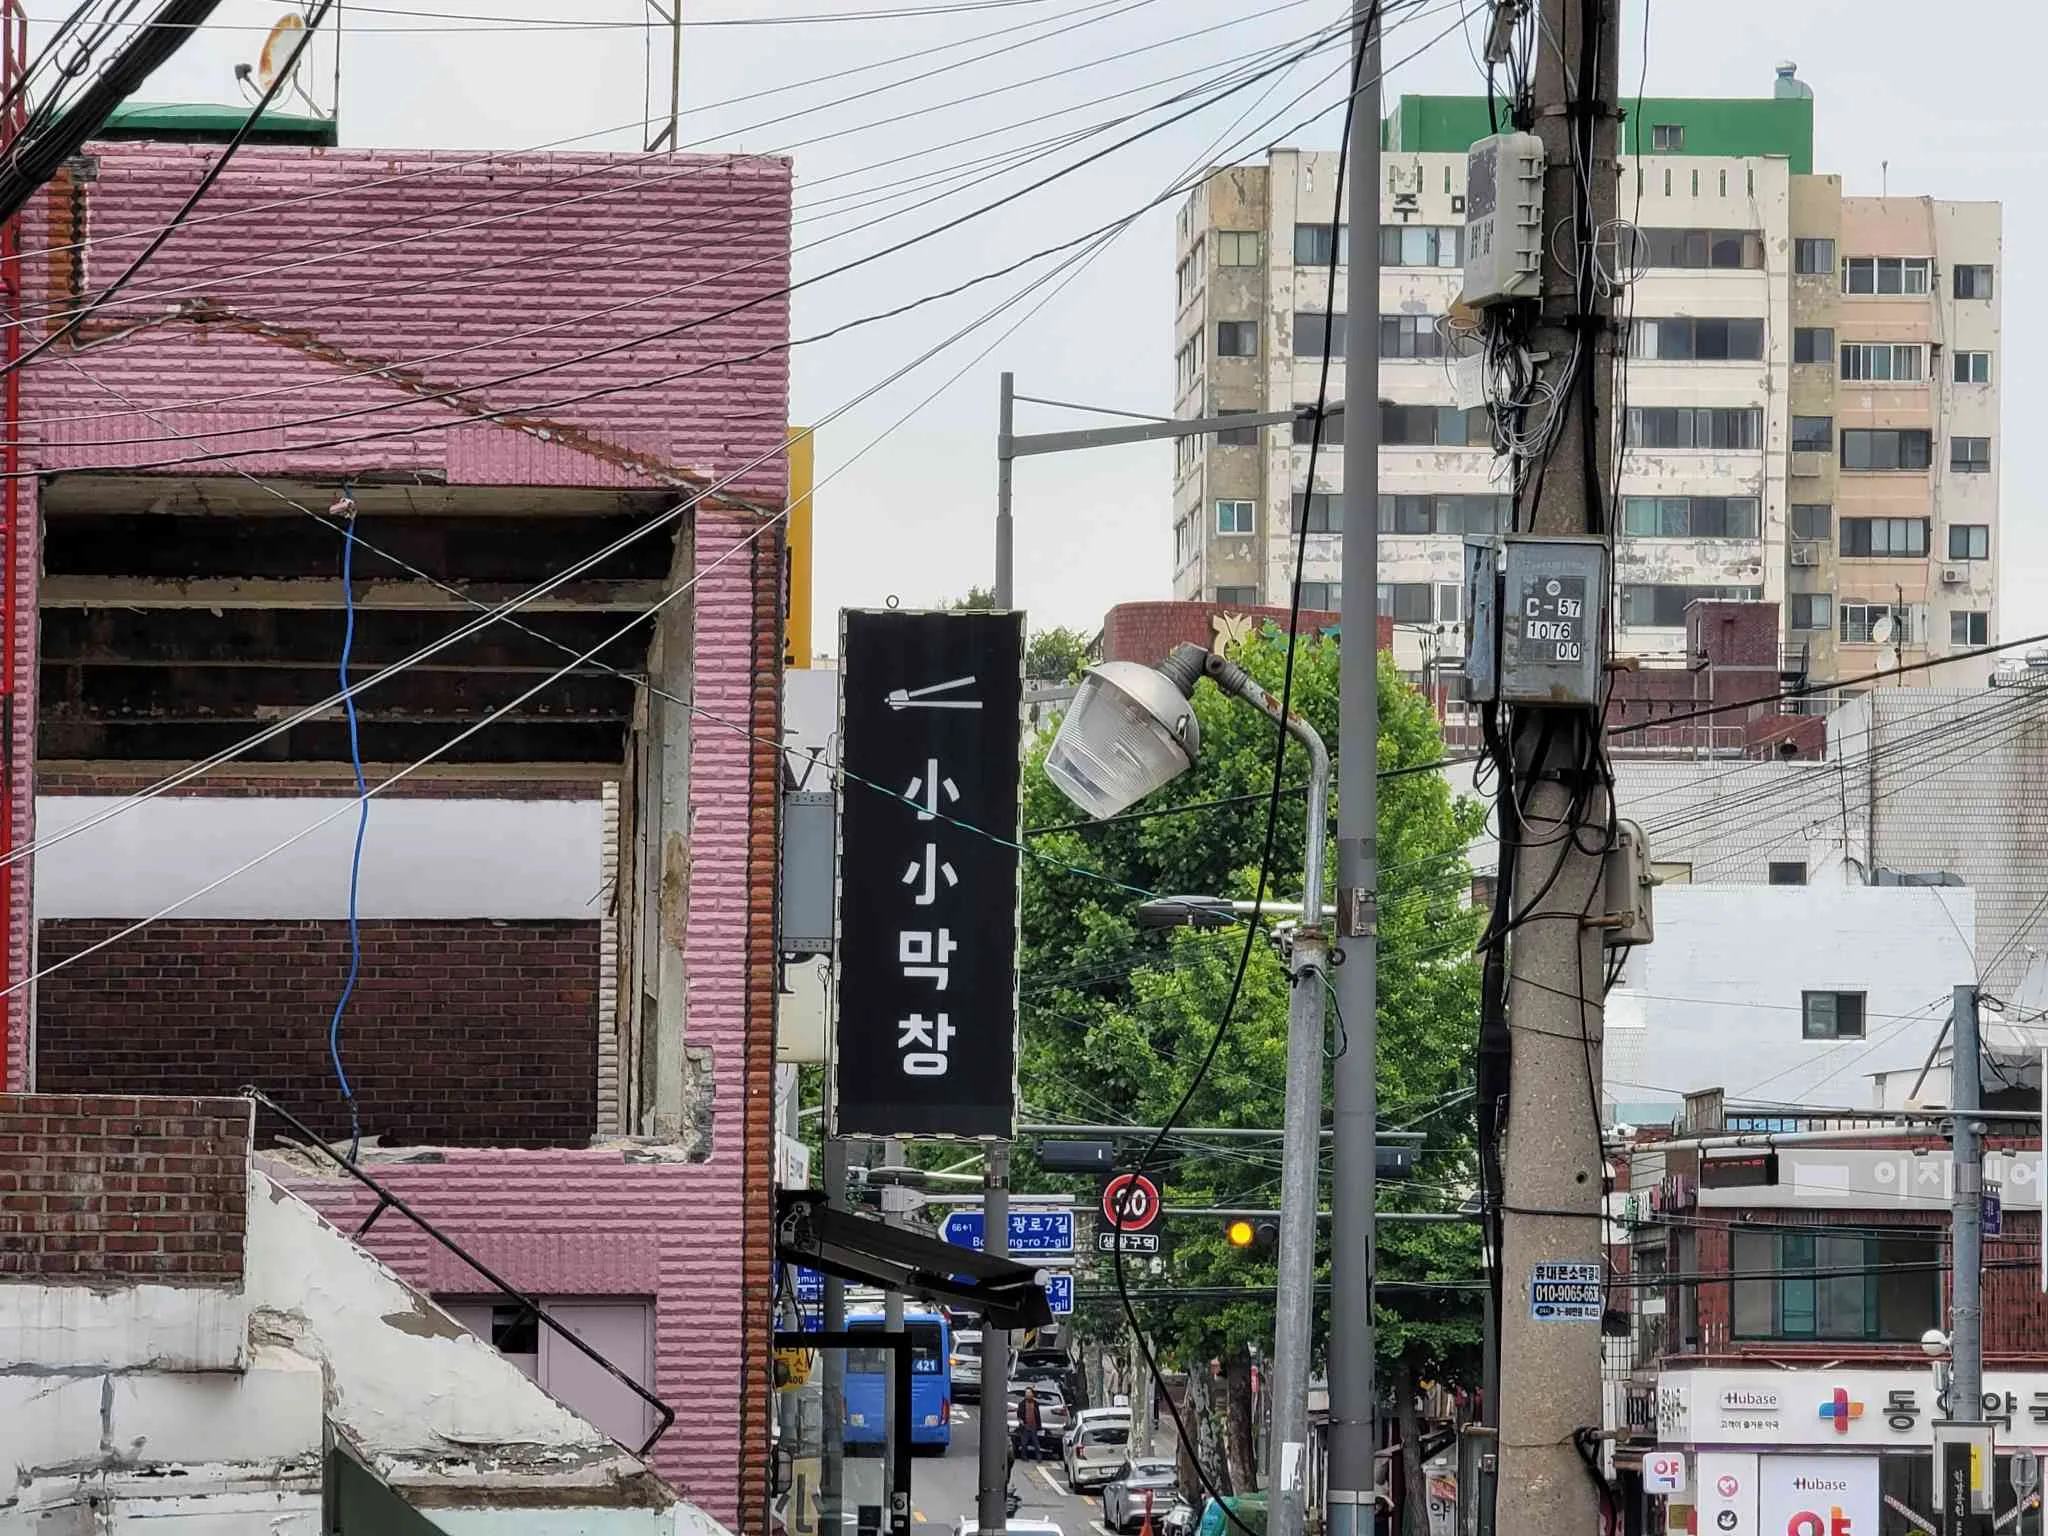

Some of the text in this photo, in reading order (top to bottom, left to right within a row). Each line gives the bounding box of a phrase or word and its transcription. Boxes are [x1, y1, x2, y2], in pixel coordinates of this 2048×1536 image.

[1529, 621, 1571, 640] 1076
[1559, 642, 1580, 659] 00
[1007, 1216, 1068, 1234] 광로7길
[1043, 1236, 1068, 1248] 7-gil
[916, 1360, 936, 1371] 421
[1724, 1392, 1777, 1405] Hubase
[1653, 1461, 1680, 1489] 약
[1792, 1477, 1848, 1491] Hubase
